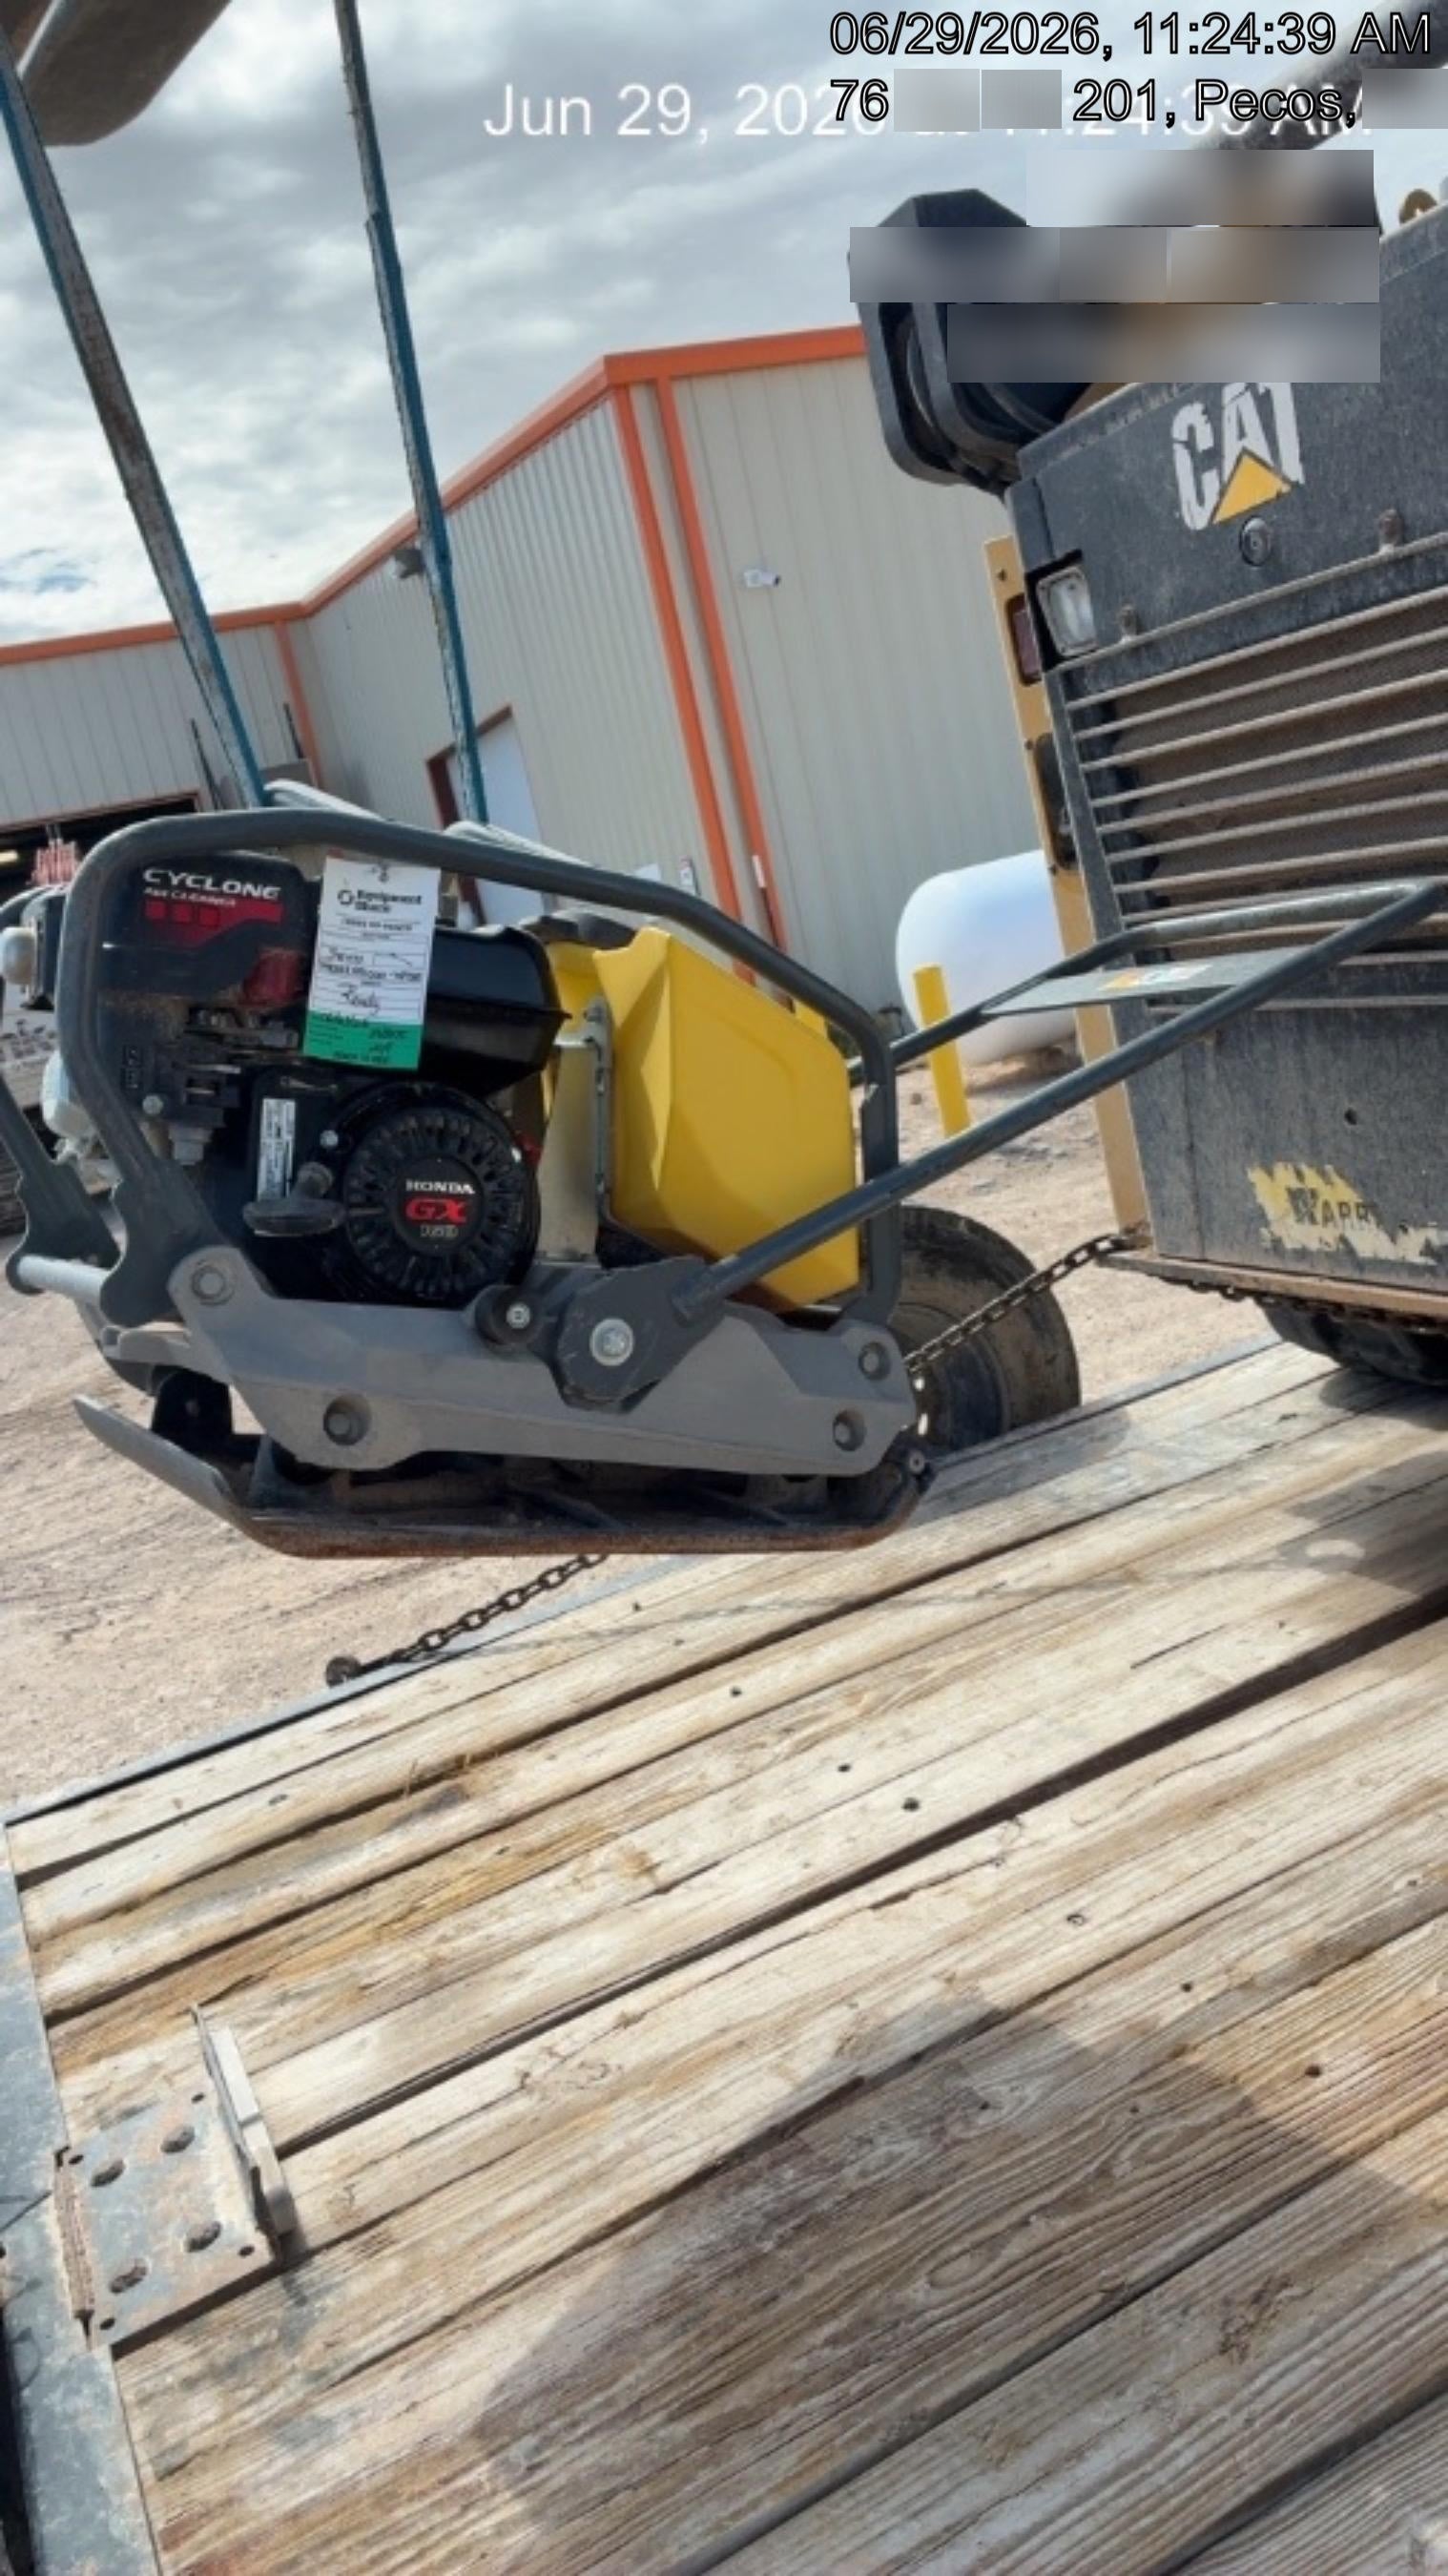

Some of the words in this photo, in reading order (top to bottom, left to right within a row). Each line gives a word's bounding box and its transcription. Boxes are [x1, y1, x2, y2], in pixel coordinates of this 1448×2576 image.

[144, 868, 281, 901] CYCLONE
[405, 1178, 475, 1195] HONDA
[405, 1198, 467, 1225] GX
